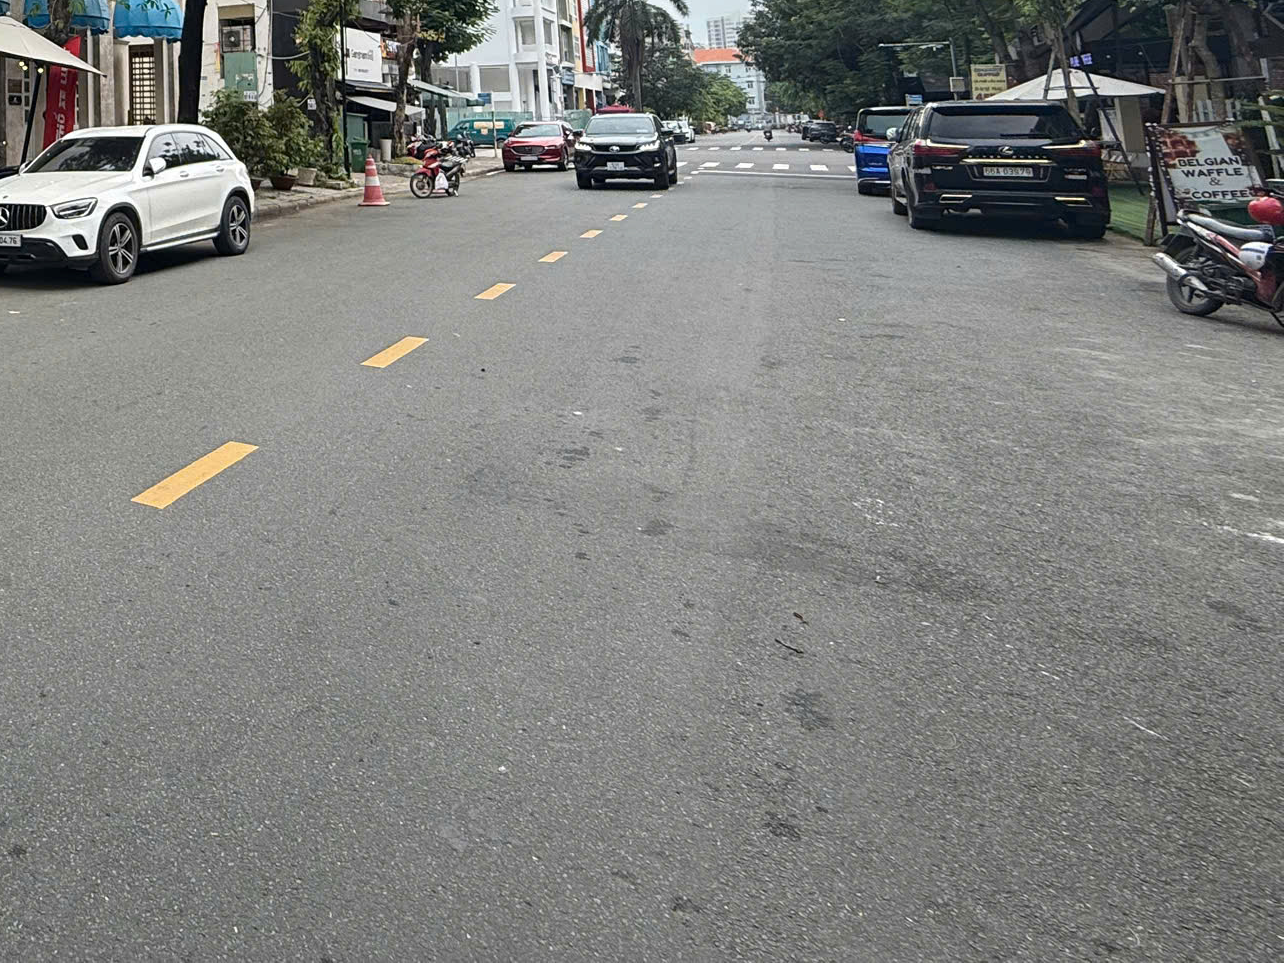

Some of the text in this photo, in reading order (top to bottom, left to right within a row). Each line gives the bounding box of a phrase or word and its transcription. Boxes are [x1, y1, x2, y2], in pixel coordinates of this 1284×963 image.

[1178, 157, 1241, 167] BELGIAN
[1181, 168, 1244, 178] WAFFLE
[1209, 177, 1224, 186] &
[1191, 189, 1249, 200] COFFEE
